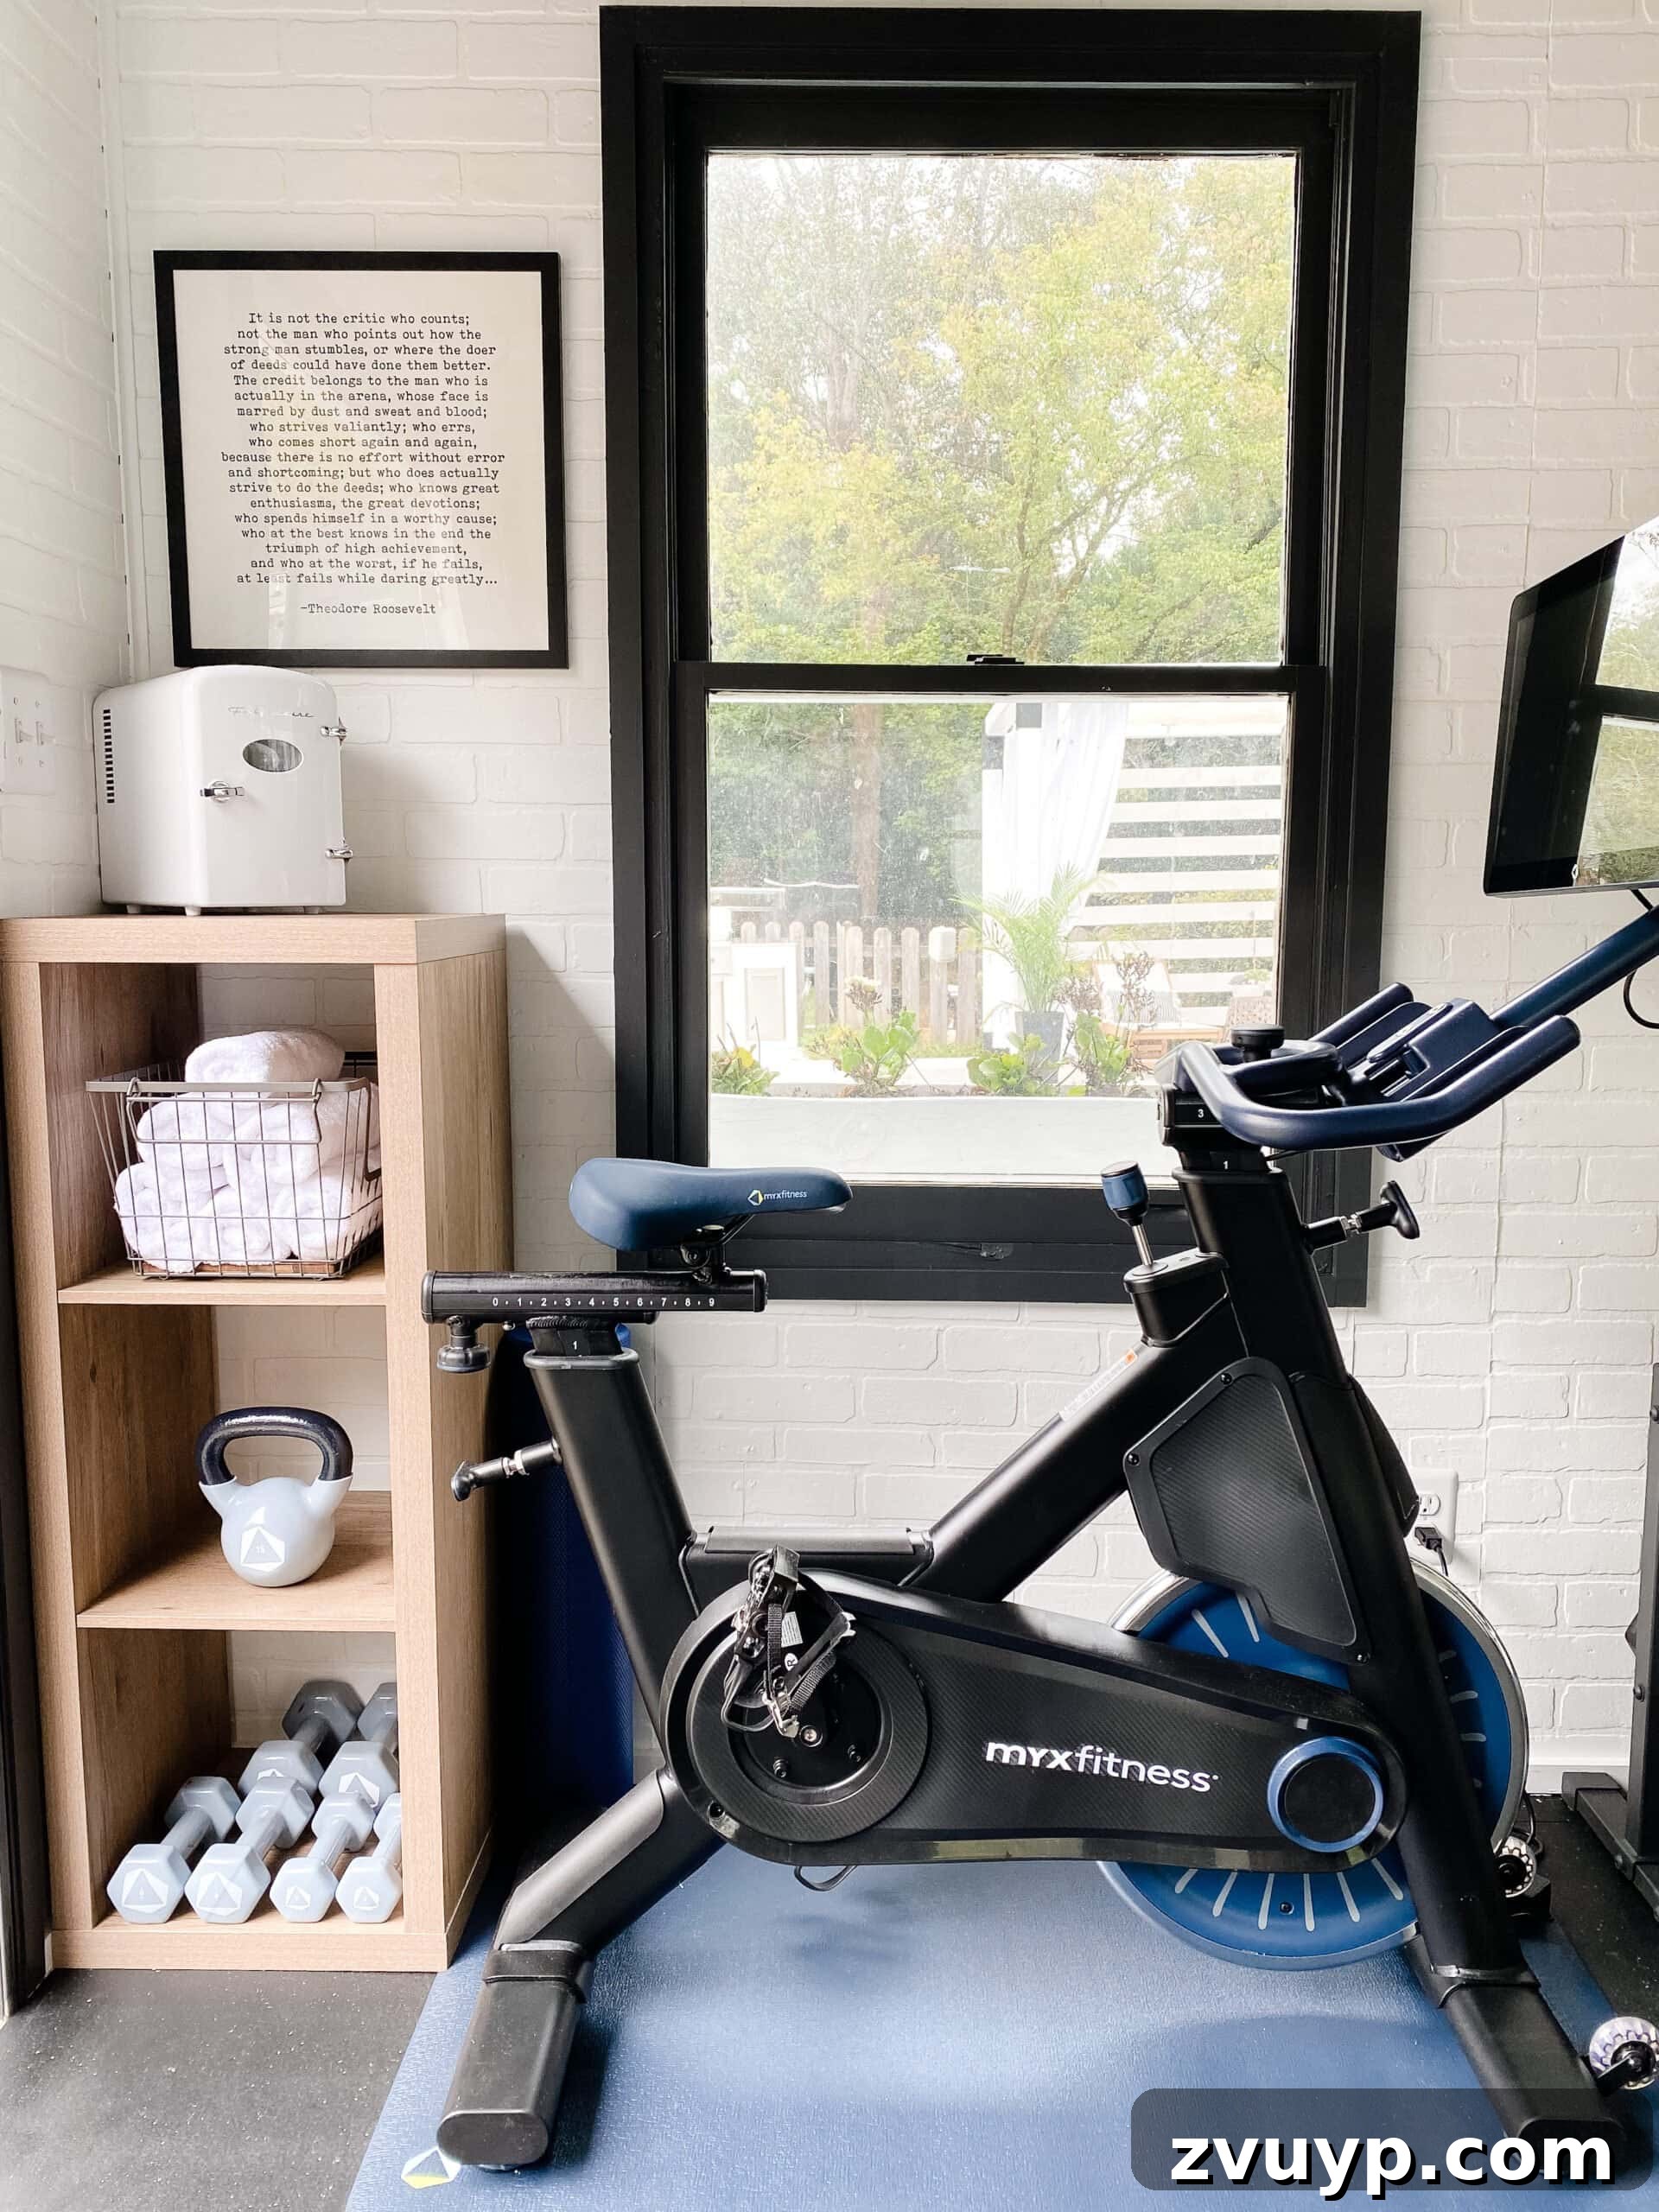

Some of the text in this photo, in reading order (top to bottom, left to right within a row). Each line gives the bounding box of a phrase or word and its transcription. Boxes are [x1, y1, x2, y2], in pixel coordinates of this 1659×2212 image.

[248, 313, 469, 326] It is not the critic who counts;
[236, 329, 260, 339] not
[265, 328, 289, 339] the
[323, 328, 349, 339] who
[353, 328, 397, 342] points
[402, 329, 425, 339] out
[429, 328, 454, 339] how
[458, 328, 482, 339] the
[224, 344, 269, 358] strong
[304, 343, 368, 357] stumbles,
[394, 343, 434, 354] where
[438, 343, 461, 354] the
[466, 343, 497, 354] doer
[230, 359, 491, 370] of deeds could have done them better.
[232, 374, 257, 385] The
[262, 374, 306, 385] credit
[310, 374, 363, 389] belongs
[365, 375, 382, 385] to
[386, 374, 410, 385] the
[444, 374, 470, 385] who
[474, 374, 489, 385] is
[234, 390, 489, 404] actually in the arena, whose face is
[237, 405, 487, 419] marred by dust and sweat and blood;
[249, 421, 475, 435] who strives valiantly; who errs,
[248, 436, 273, 447] who
[319, 436, 357, 447] short
[361, 436, 400, 450] again
[404, 436, 429, 447] and
[434, 436, 477, 450] again,
[220, 451, 272, 461] because
[276, 451, 315, 461] there
[319, 451, 333, 461] is
[359, 451, 404, 461] effort
[409, 451, 461, 461] without
[228, 467, 499, 480] and shortcoming; but who does actually
[229, 481, 499, 496] strive to do the deeds; who knows great
[250, 497, 480, 512] enthusiasms, the great devotions;
[234, 512, 259, 523] who
[264, 512, 308, 526] spends
[312, 512, 365, 523] himself
[370, 512, 386, 523] in
[404, 512, 450, 526] worthy
[456, 516, 497, 525] cause;
[241, 527, 492, 537] who at the best knows in the end the
[265, 543, 467, 556] triumph of high achievement,
[251, 557, 483, 570] and who at the worst, if he fails,
[237, 573, 498, 587] at least fails while daring greatly...
[372, 602, 436, 613] Roosevelt
[1198, 1109, 1205, 1118] 3
[1223, 1160, 1229, 1170] 1
[763, 1189, 808, 1200] myxfitness
[493, 1298, 715, 1307] 0 1 2 3 4 5 6 7 8 9
[572, 1341, 578, 1350] 1
[985, 1740, 1211, 1794] myxfitness
